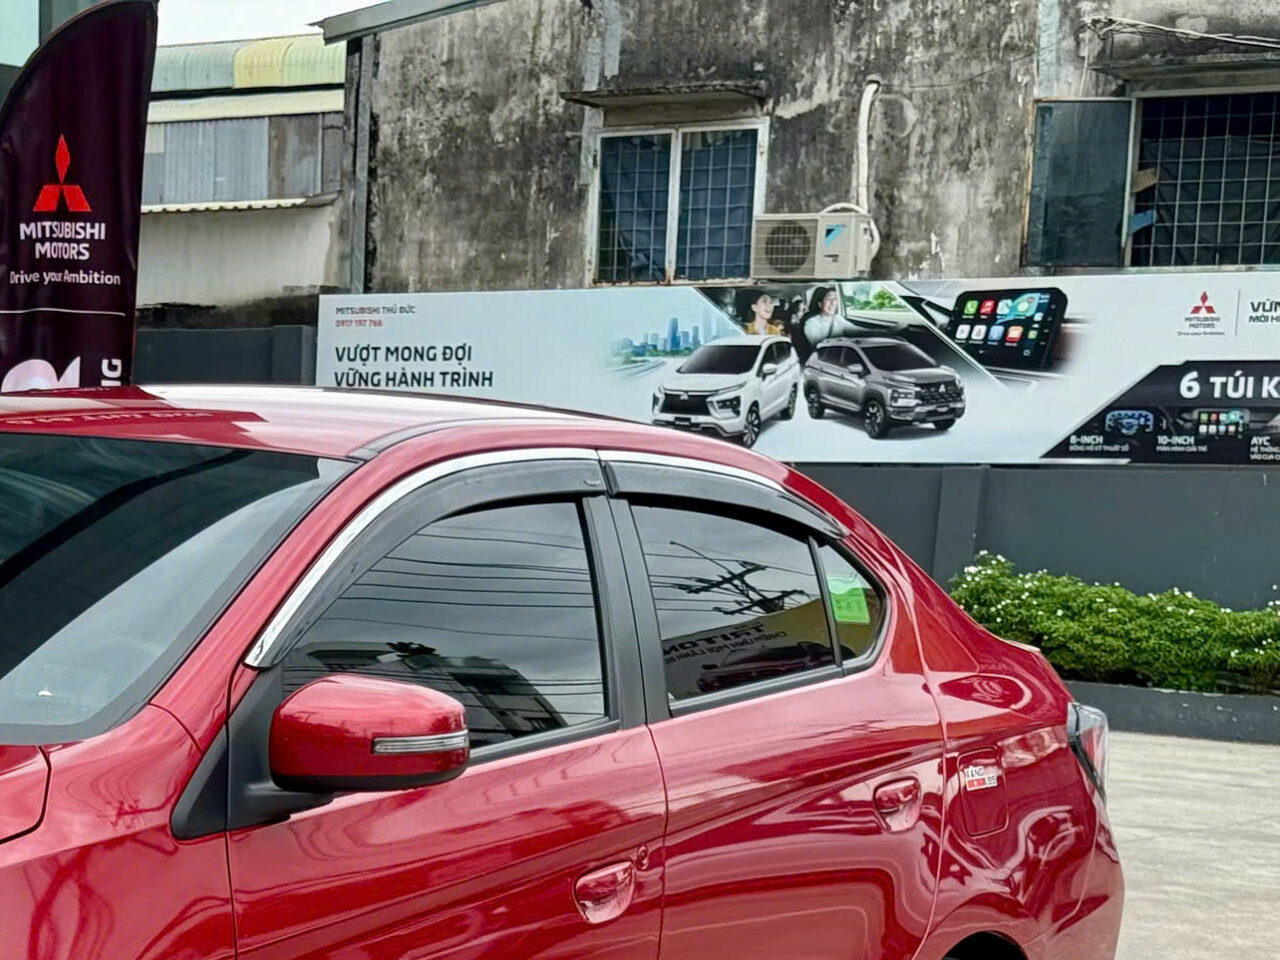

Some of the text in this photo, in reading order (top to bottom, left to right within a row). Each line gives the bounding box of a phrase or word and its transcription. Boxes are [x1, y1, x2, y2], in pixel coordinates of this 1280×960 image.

[20, 221, 106, 240] MITSUBISHI
[35, 242, 90, 260] MOTORS
[10, 269, 121, 285] Drive your Ambition
[335, 343, 472, 367] VƯỢT MONG ĐỢI
[334, 367, 494, 387] VỮNG HÀNH TRÌNH
[1180, 371, 1201, 398] 6
[1210, 370, 1254, 398] TÚI
[1070, 435, 1104, 444] 8-INCH
[1157, 435, 1195, 445] 10-INCH
[1251, 436, 1271, 446] AYC
